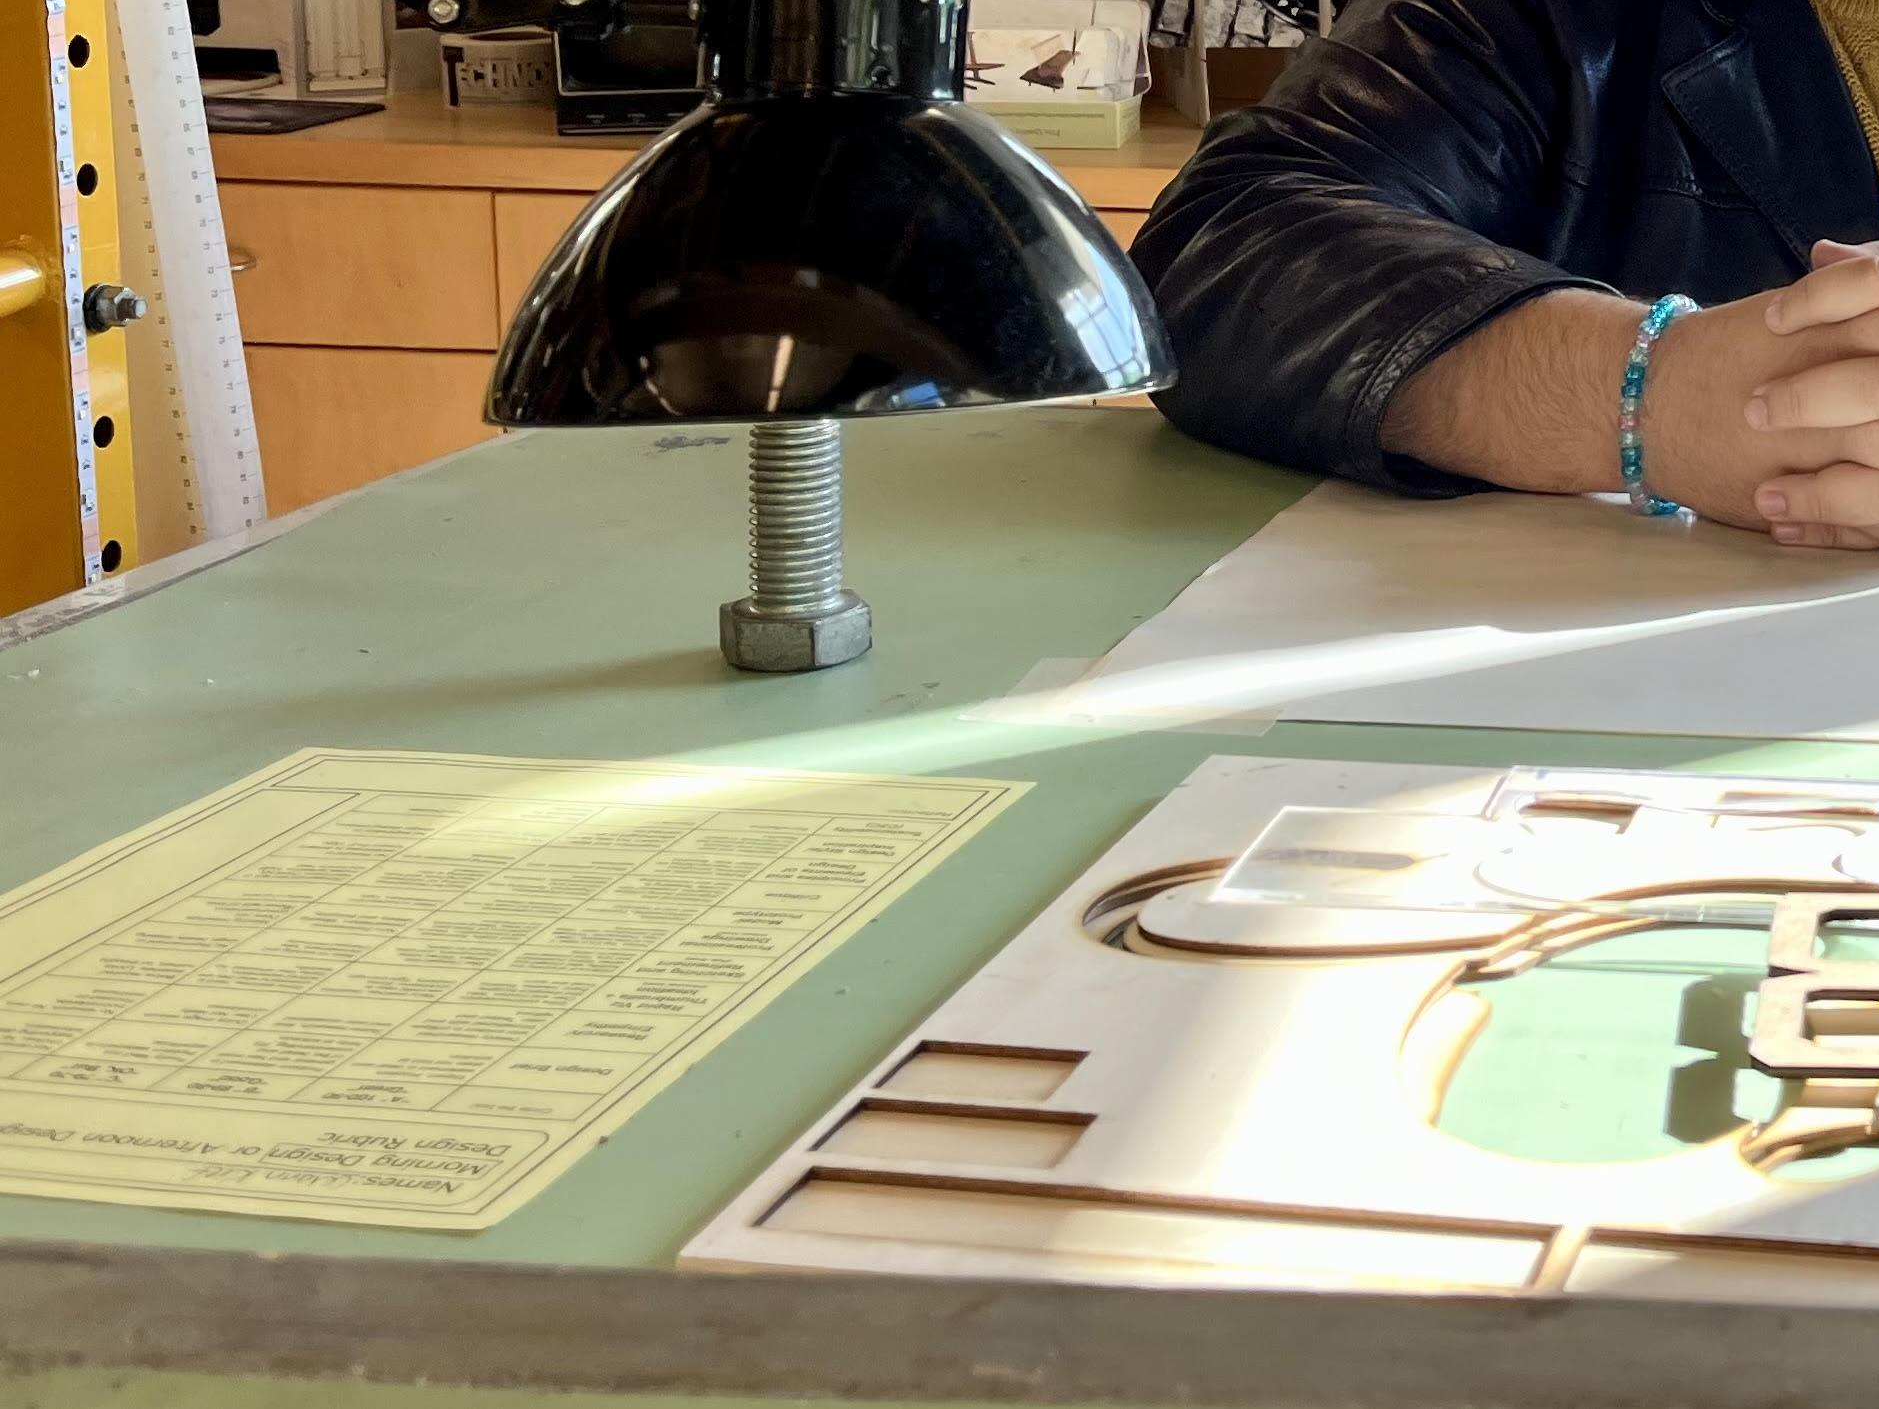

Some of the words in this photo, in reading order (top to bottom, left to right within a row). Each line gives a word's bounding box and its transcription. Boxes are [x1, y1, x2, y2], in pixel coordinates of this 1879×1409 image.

[554, 1064, 612, 1075] Design
[81, 1133, 220, 1156] Afternoon
[316, 1130, 403, 1151] Rubric
[414, 1136, 512, 1159] Design
[266, 1145, 355, 1168] Design
[374, 1153, 484, 1176] Morning
[357, 1173, 459, 1196] Names:
